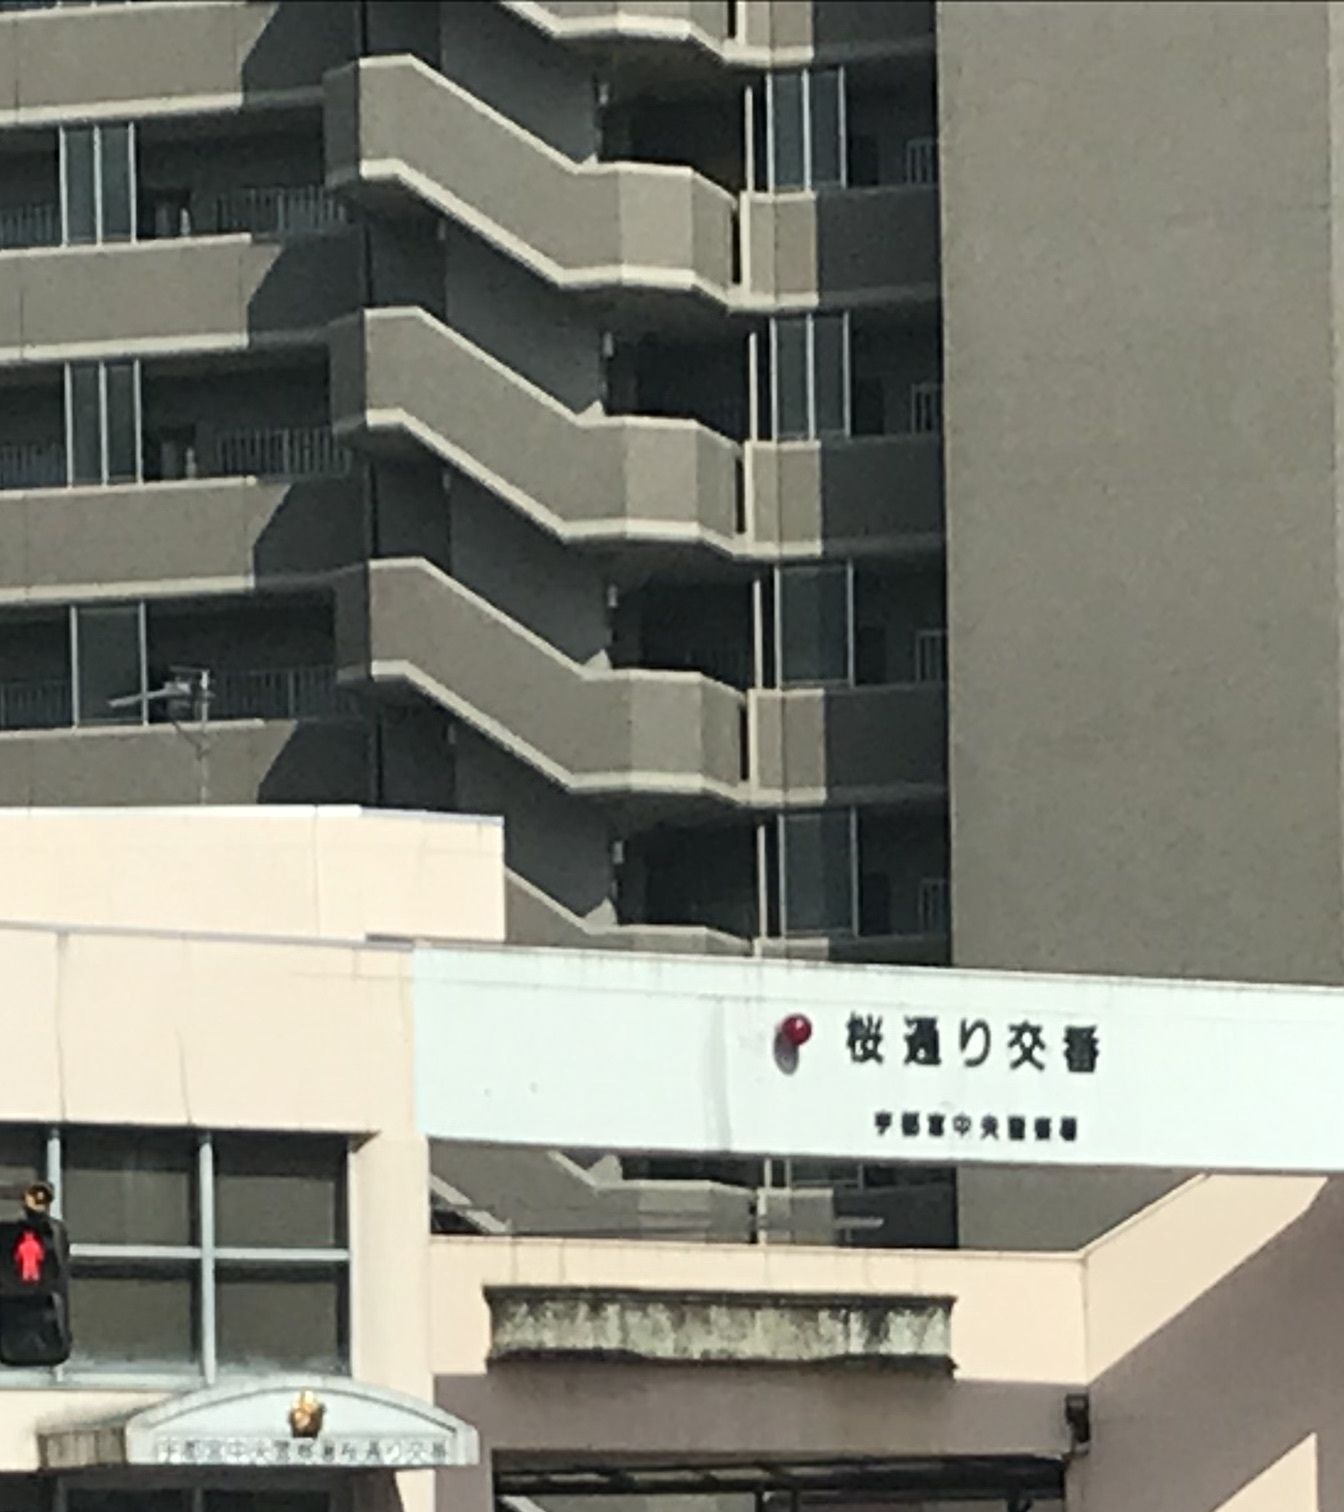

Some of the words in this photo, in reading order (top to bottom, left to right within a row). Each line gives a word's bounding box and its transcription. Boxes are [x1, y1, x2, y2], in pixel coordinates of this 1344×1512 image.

[846, 1012, 1099, 1073] 桜通り交番
